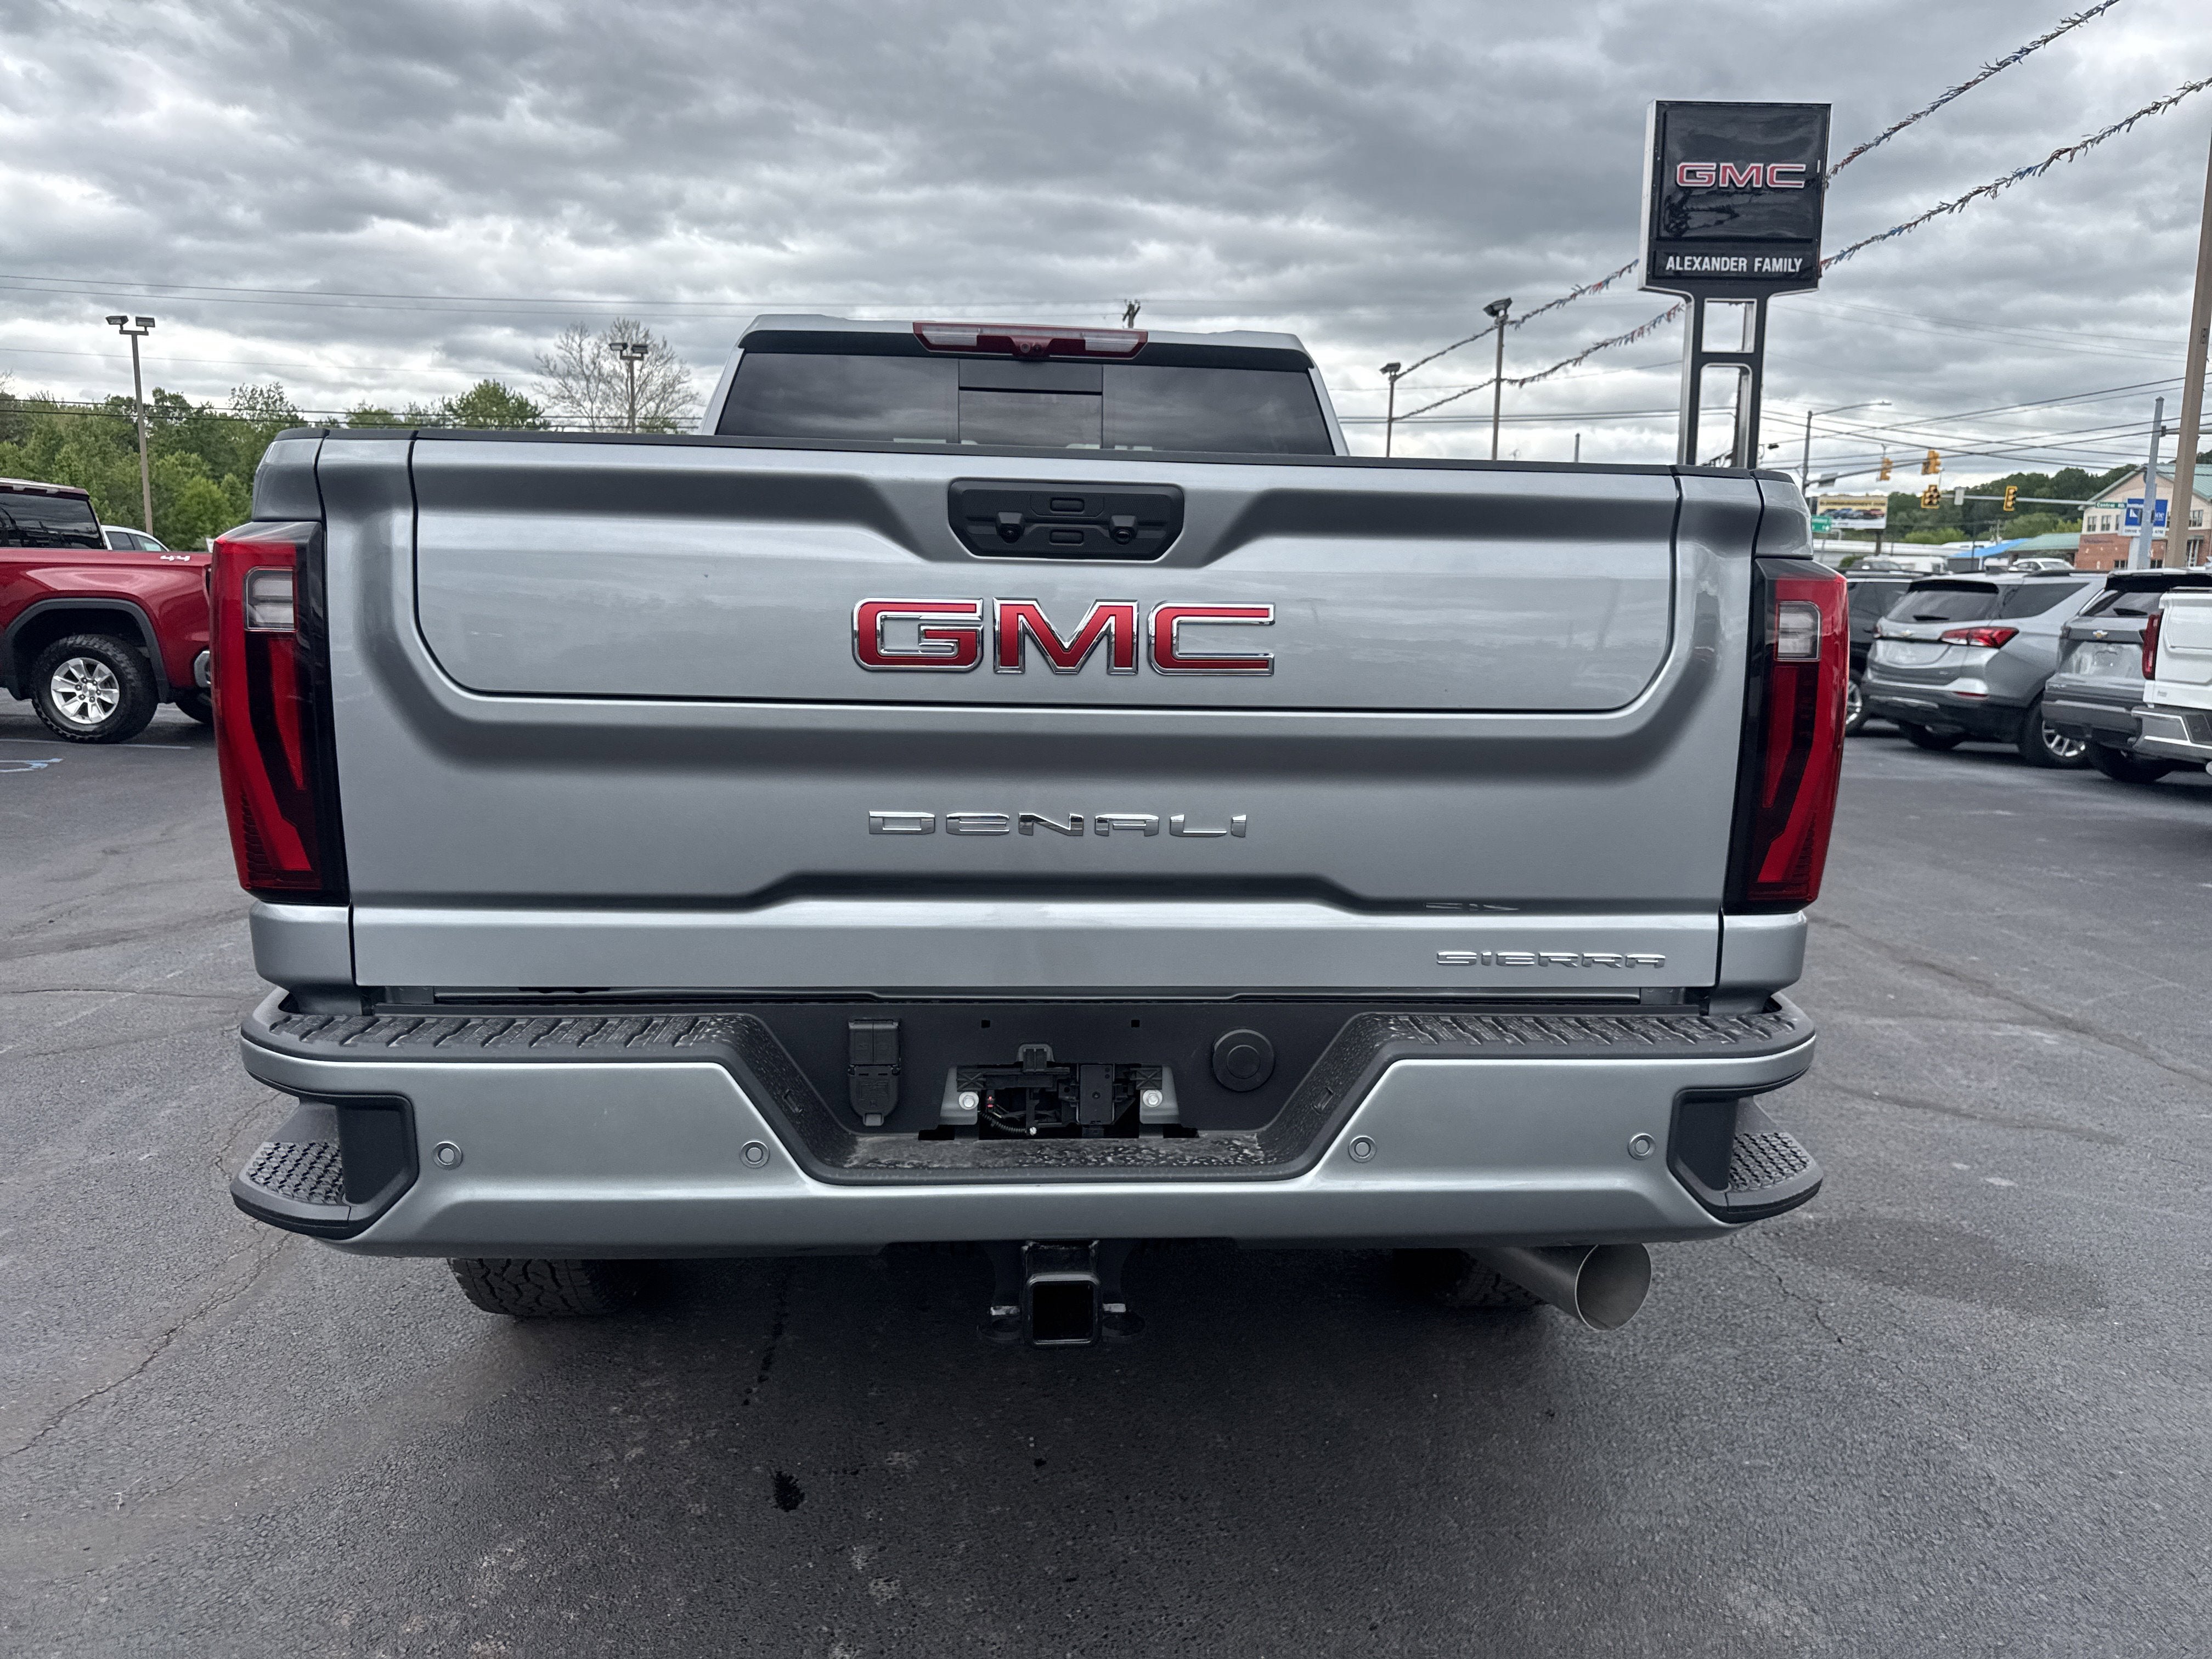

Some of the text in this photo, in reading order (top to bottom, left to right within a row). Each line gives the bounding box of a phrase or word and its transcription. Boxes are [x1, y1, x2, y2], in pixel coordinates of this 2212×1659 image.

[1677, 162, 1806, 188] GMC
[1666, 256, 1803, 273] ALEXANDER FAMILY
[851, 597, 1276, 676] GMC
[868, 810, 1247, 838] DENALI
[1436, 951, 1666, 968] SIERRA
